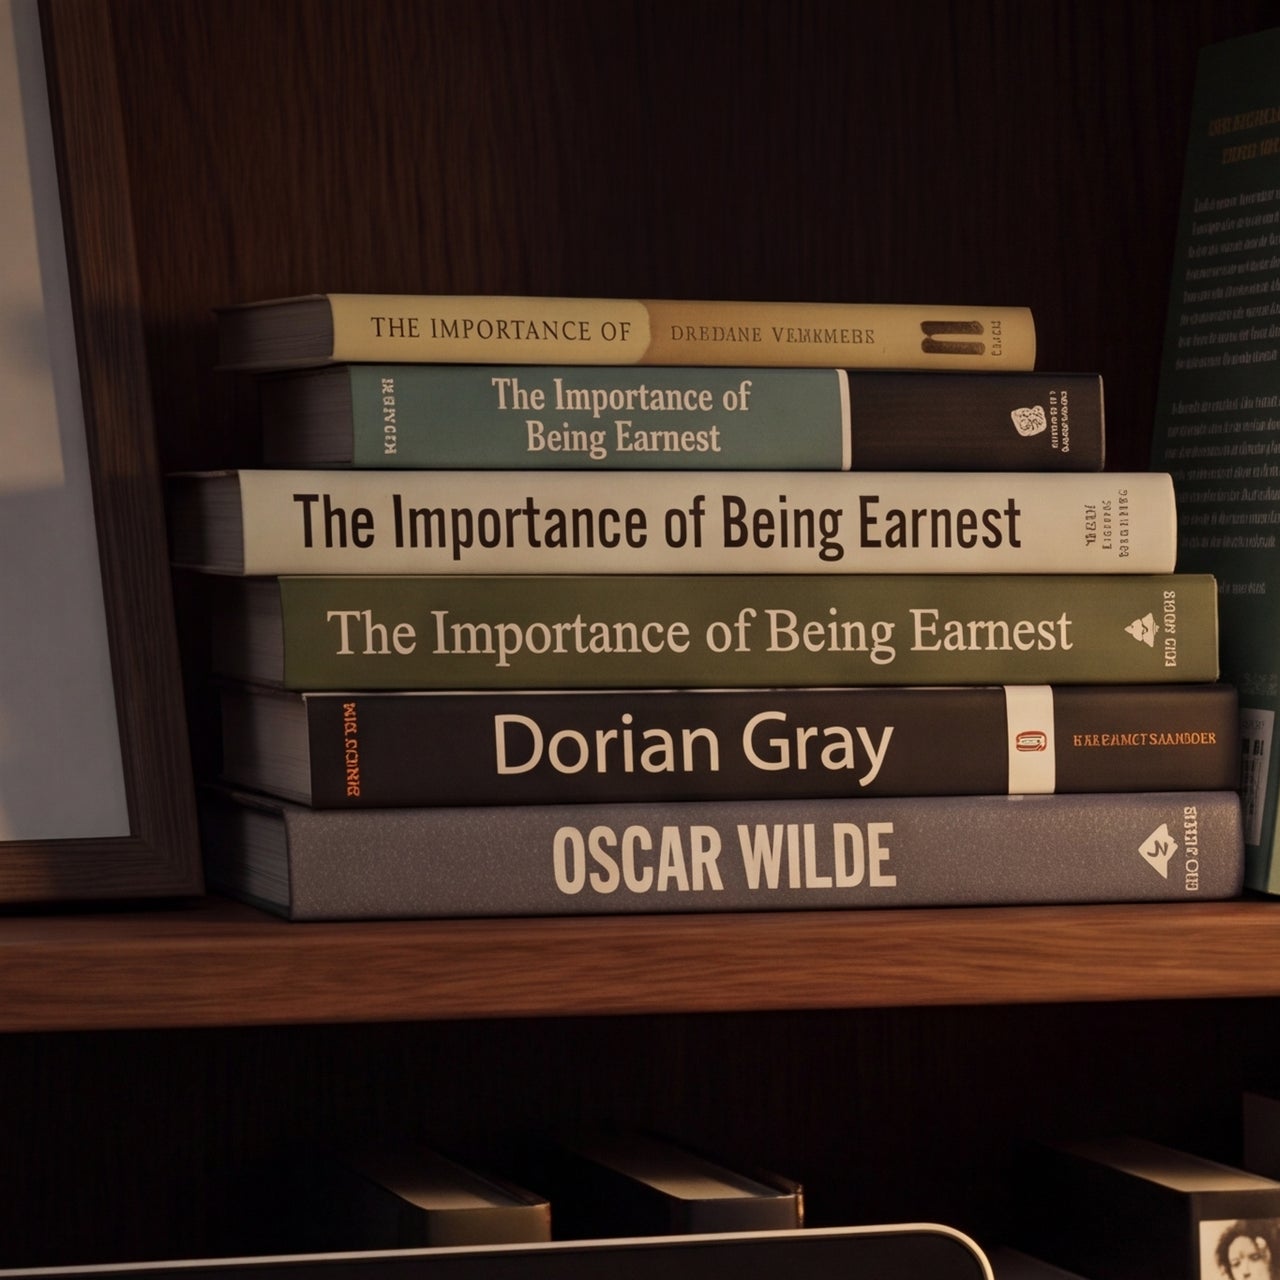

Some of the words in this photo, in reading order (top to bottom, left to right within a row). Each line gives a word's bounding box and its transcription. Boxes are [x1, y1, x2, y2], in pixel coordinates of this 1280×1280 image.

[371, 317, 420, 338] THE
[431, 318, 591, 341] IMPORTANCE
[601, 322, 631, 341] OF
[492, 378, 545, 411] The
[553, 378, 713, 417] Importance
[723, 381, 752, 410] of
[527, 420, 606, 460] Being
[615, 421, 721, 452] Earnest
[293, 494, 374, 548] The
[393, 494, 648, 560] Importance
[665, 495, 705, 548] of
[723, 495, 843, 561] Being
[860, 495, 1021, 548] Earnest
[327, 609, 416, 657] The
[432, 609, 694, 668] Importance
[705, 608, 751, 655] of
[765, 608, 896, 664] Being
[909, 608, 1073, 651] Earnest
[494, 714, 720, 775] Dorian
[741, 711, 895, 787] Gray
[552, 825, 722, 895] OSCAR
[737, 822, 896, 891] WILDE
